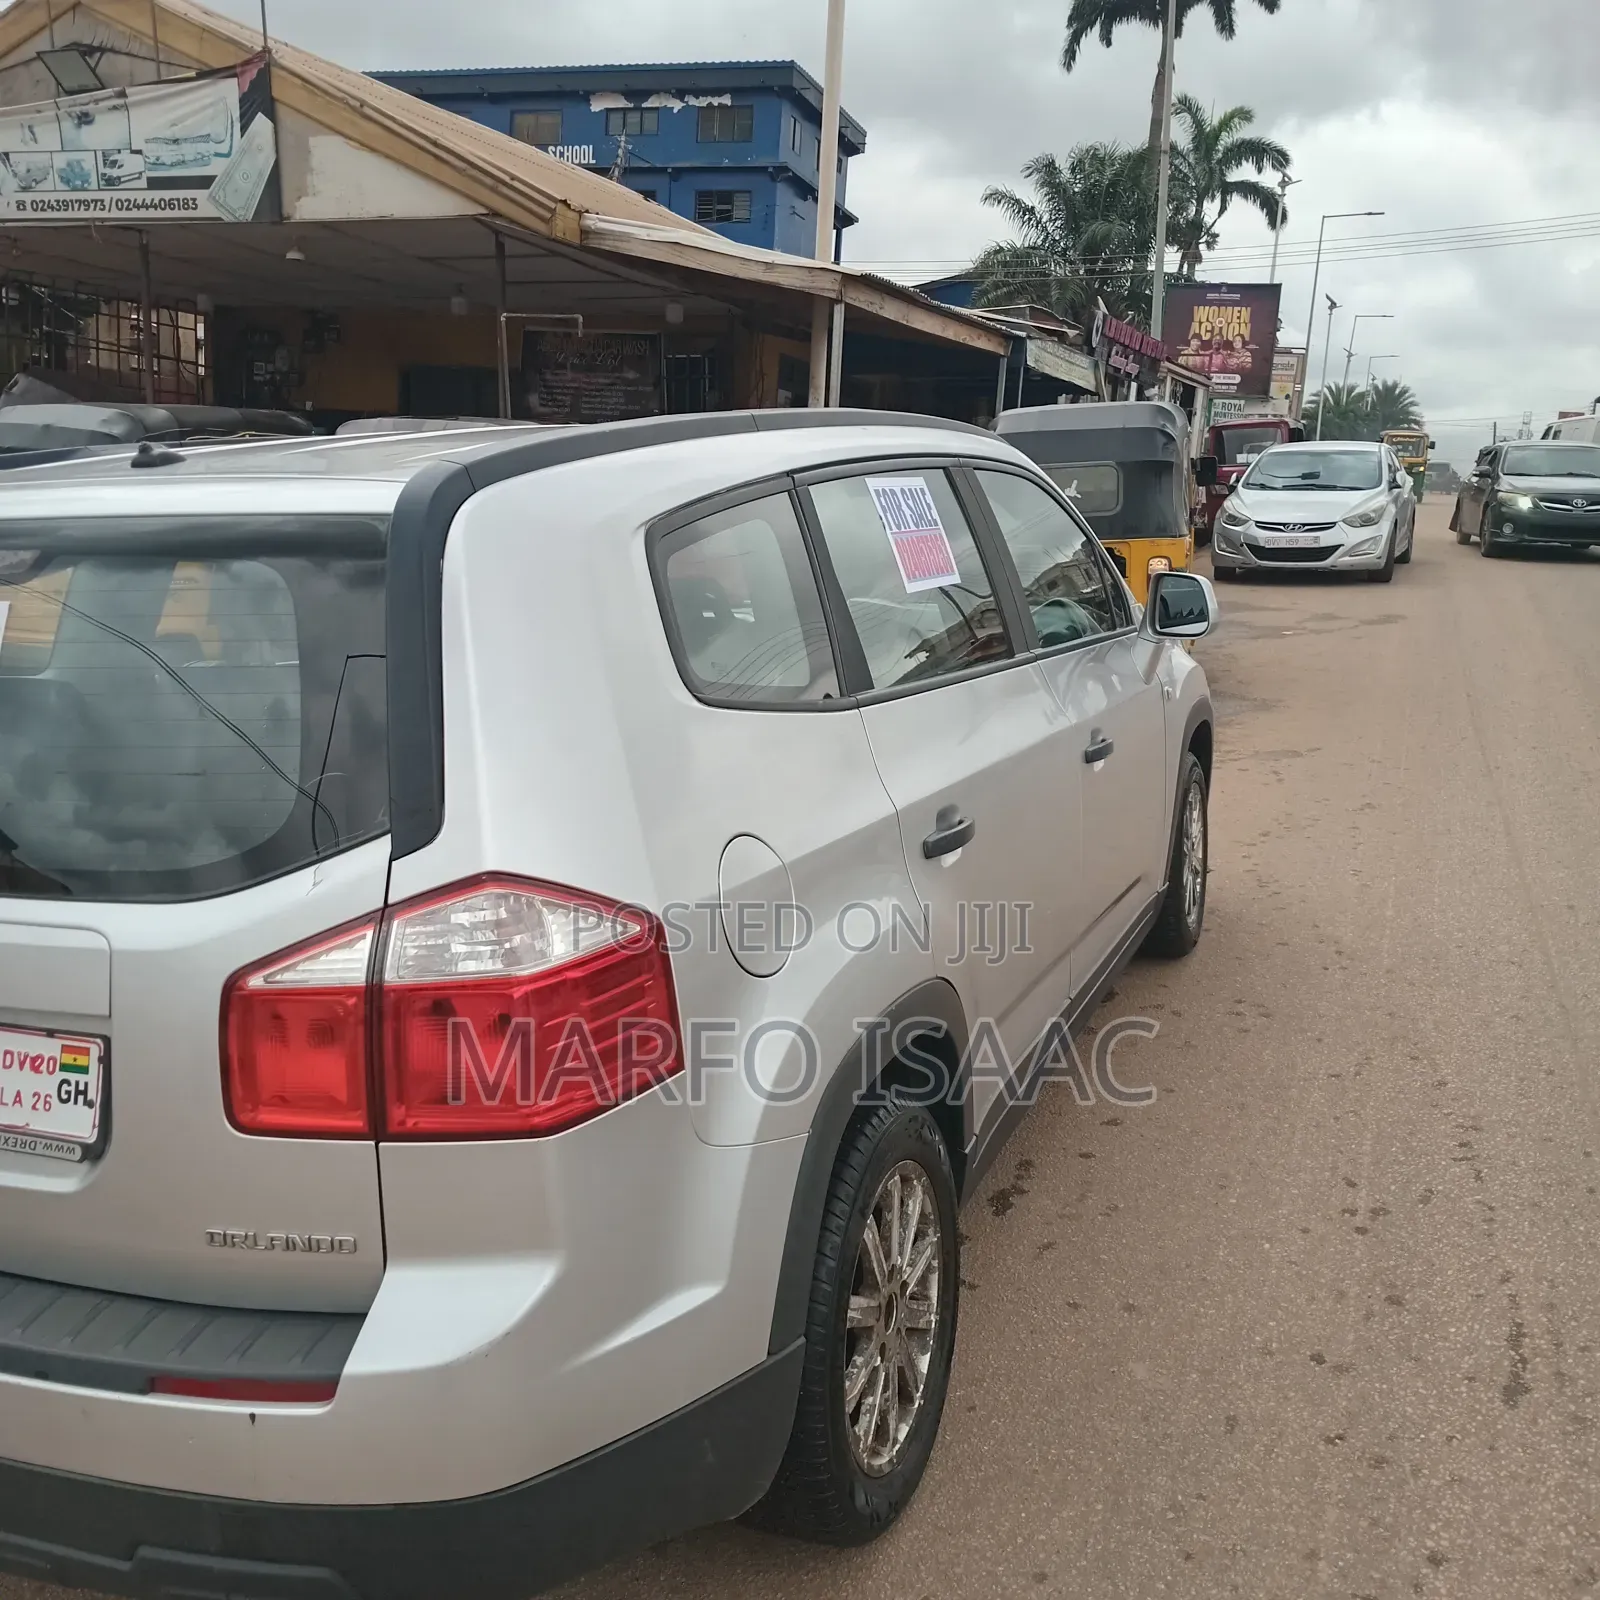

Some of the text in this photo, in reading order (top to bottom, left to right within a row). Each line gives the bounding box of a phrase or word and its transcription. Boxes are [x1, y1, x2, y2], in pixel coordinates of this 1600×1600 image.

[547, 144, 597, 164] SCHOOL
[1193, 306, 1251, 323] WOMEN
[1188, 322, 1251, 341] ACTION
[873, 487, 939, 531] FOR SALE
[31, 1091, 53, 1112] 26
[57, 1078, 89, 1107] GH
[0, 1136, 76, 1156] www.DREX
[205, 1229, 357, 1254] ORLANDO
